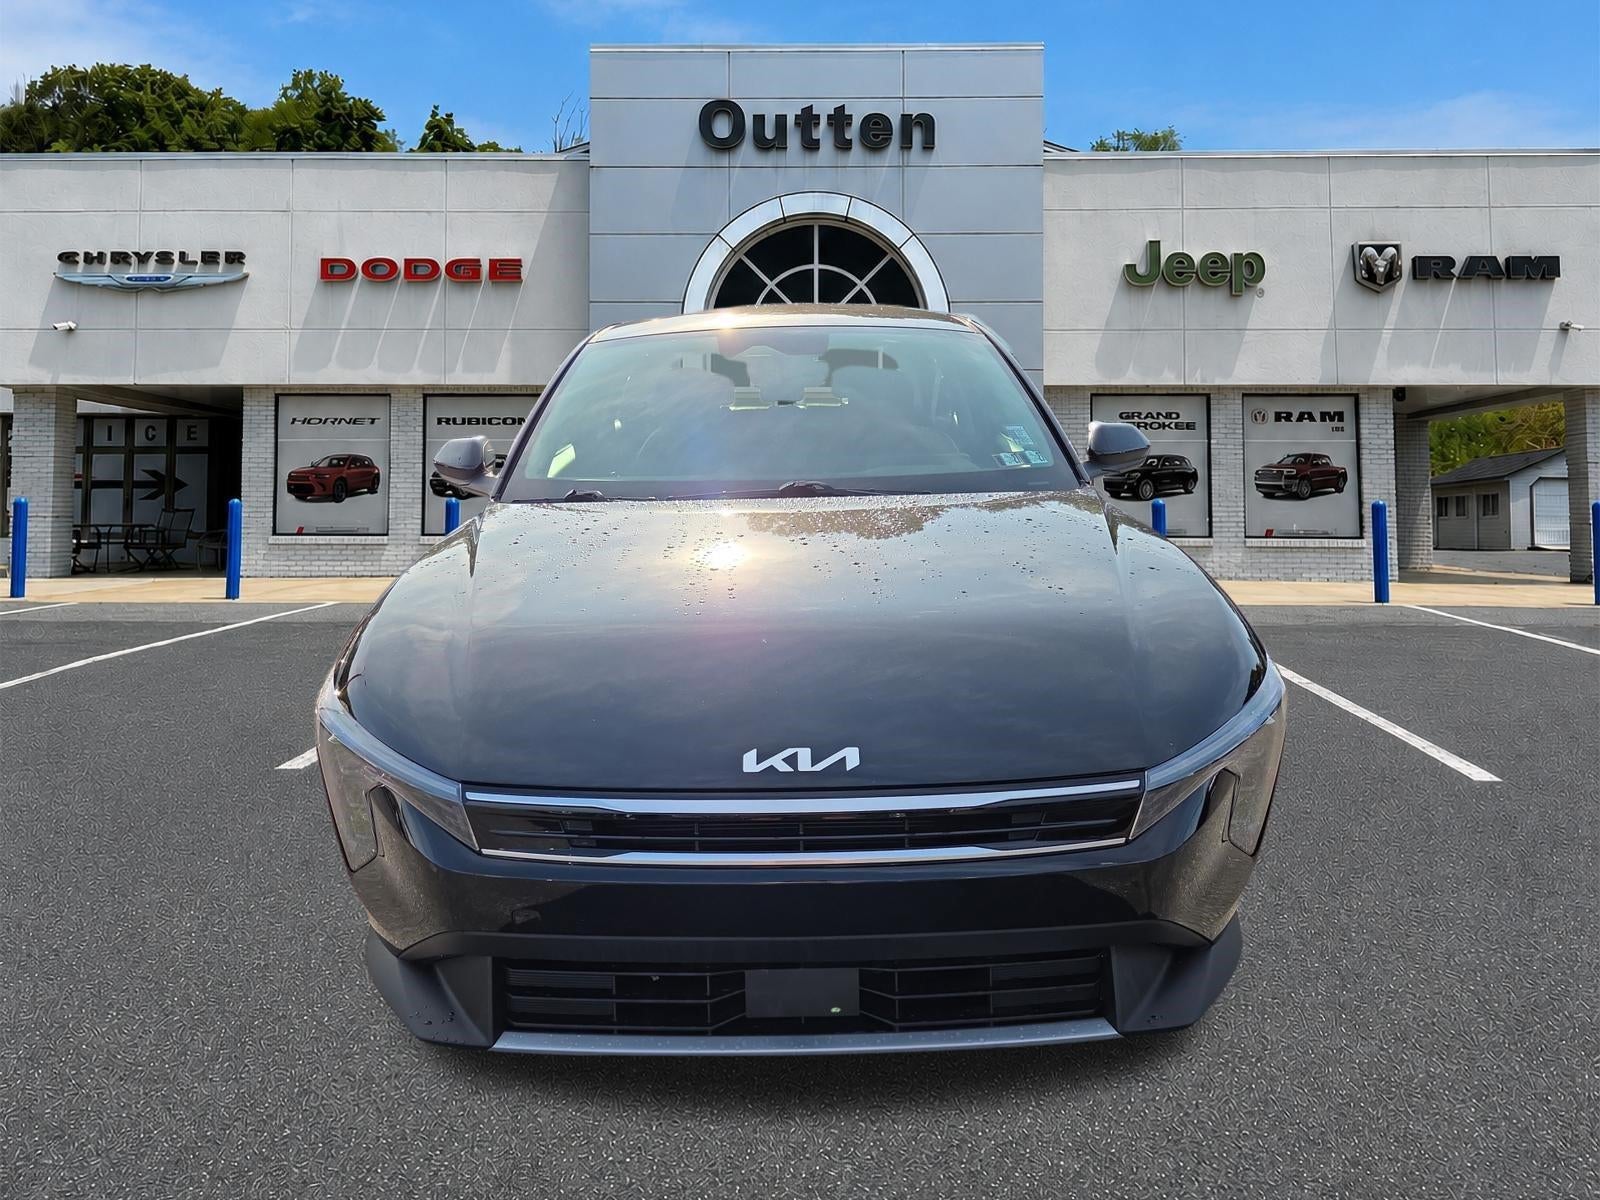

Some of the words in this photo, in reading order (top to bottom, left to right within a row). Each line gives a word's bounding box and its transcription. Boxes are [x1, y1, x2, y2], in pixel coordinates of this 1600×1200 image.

[699, 99, 935, 150] Outten
[56, 250, 247, 266] CHRYSLER
[1123, 239, 1266, 296] Jeep
[1411, 255, 1561, 280] RAM
[319, 256, 524, 283] DODGE
[290, 416, 381, 426] HORNET
[1118, 411, 1180, 420] GRAND
[1274, 410, 1345, 423] RAM
[1122, 421, 1197, 431] ROKEE
[742, 746, 860, 773] KIA
